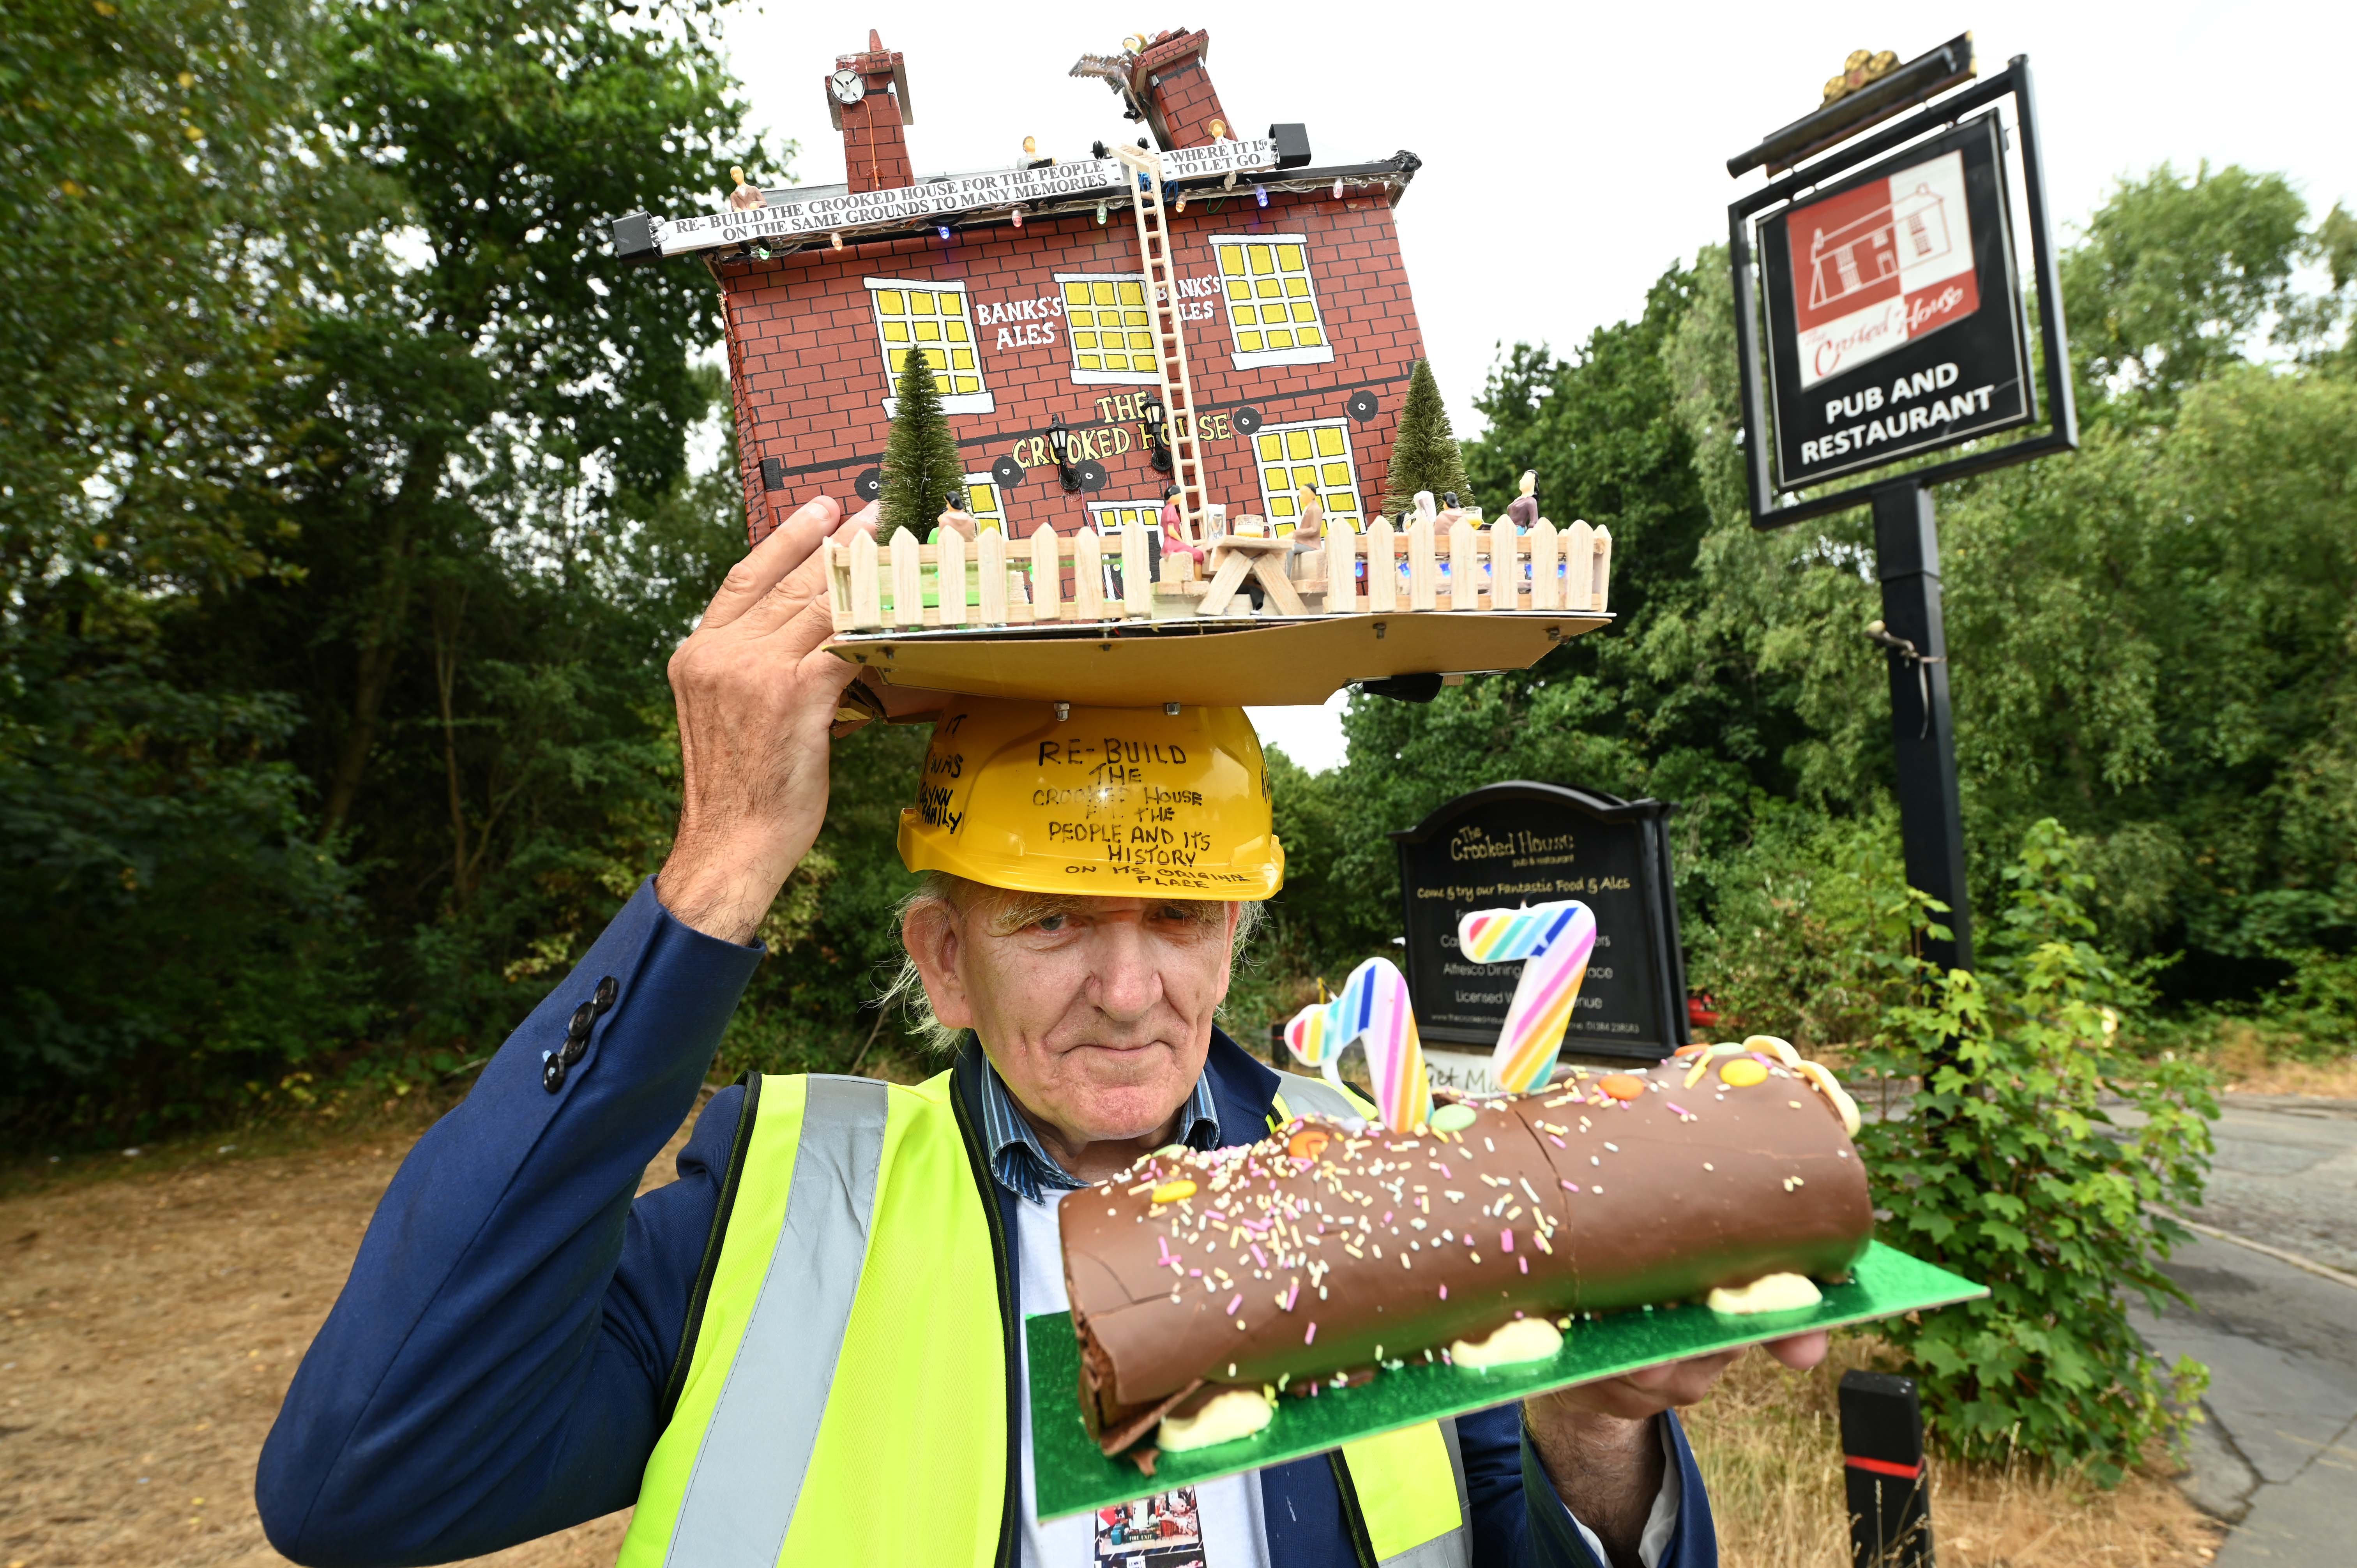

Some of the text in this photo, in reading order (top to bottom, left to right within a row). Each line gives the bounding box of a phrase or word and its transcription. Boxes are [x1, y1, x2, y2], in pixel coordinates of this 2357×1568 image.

[1232, 141, 1248, 155] IT
[1175, 162, 1198, 175] TO
[1202, 157, 1233, 171] LET
[1237, 153, 1261, 166] GO
[708, 210, 765, 228] BUILD
[768, 203, 804, 219] THE
[808, 191, 896, 214] CROOKED
[901, 182, 958, 201] HOUSE
[961, 176, 997, 192] FOR
[999, 171, 1035, 186] THE
[1037, 161, 1104, 181] PEOPLE
[723, 226, 748, 241] ON
[751, 220, 788, 235] THE
[792, 212, 842, 231] SAME
[845, 200, 929, 223] GROUNDS
[932, 196, 956, 210] TO
[960, 188, 1011, 207] MANY
[1013, 173, 1107, 199] MEMORIES
[1156, 274, 1221, 301] BNKS'S
[1168, 300, 1214, 324] LES
[996, 321, 1056, 351] ALES
[1825, 362, 1959, 424] PUB AND
[1801, 384, 1995, 464] RESTAURANT
[1089, 762, 1141, 786] THE
[1144, 786, 1203, 807] HOUSE
[1134, 806, 1175, 823] THE
[1048, 821, 1121, 844] PEOPLE
[1131, 826, 1174, 844] AND
[1459, 825, 1482, 844] The
[1108, 844, 1196, 868] HISTORY
[1450, 829, 1576, 861] Crooked House
[1065, 865, 1097, 874] ON
[1512, 858, 1528, 868] pub
[1417, 887, 1445, 899] Come
[1456, 886, 1474, 902] try
[1476, 885, 1494, 896] our
[1497, 878, 1553, 894] Fantastic
[1556, 877, 1585, 892] Food
[1599, 876, 1631, 890] Ales
[1443, 962, 1521, 980] Alfresco Dining
[1455, 990, 1503, 1005] Licensed
